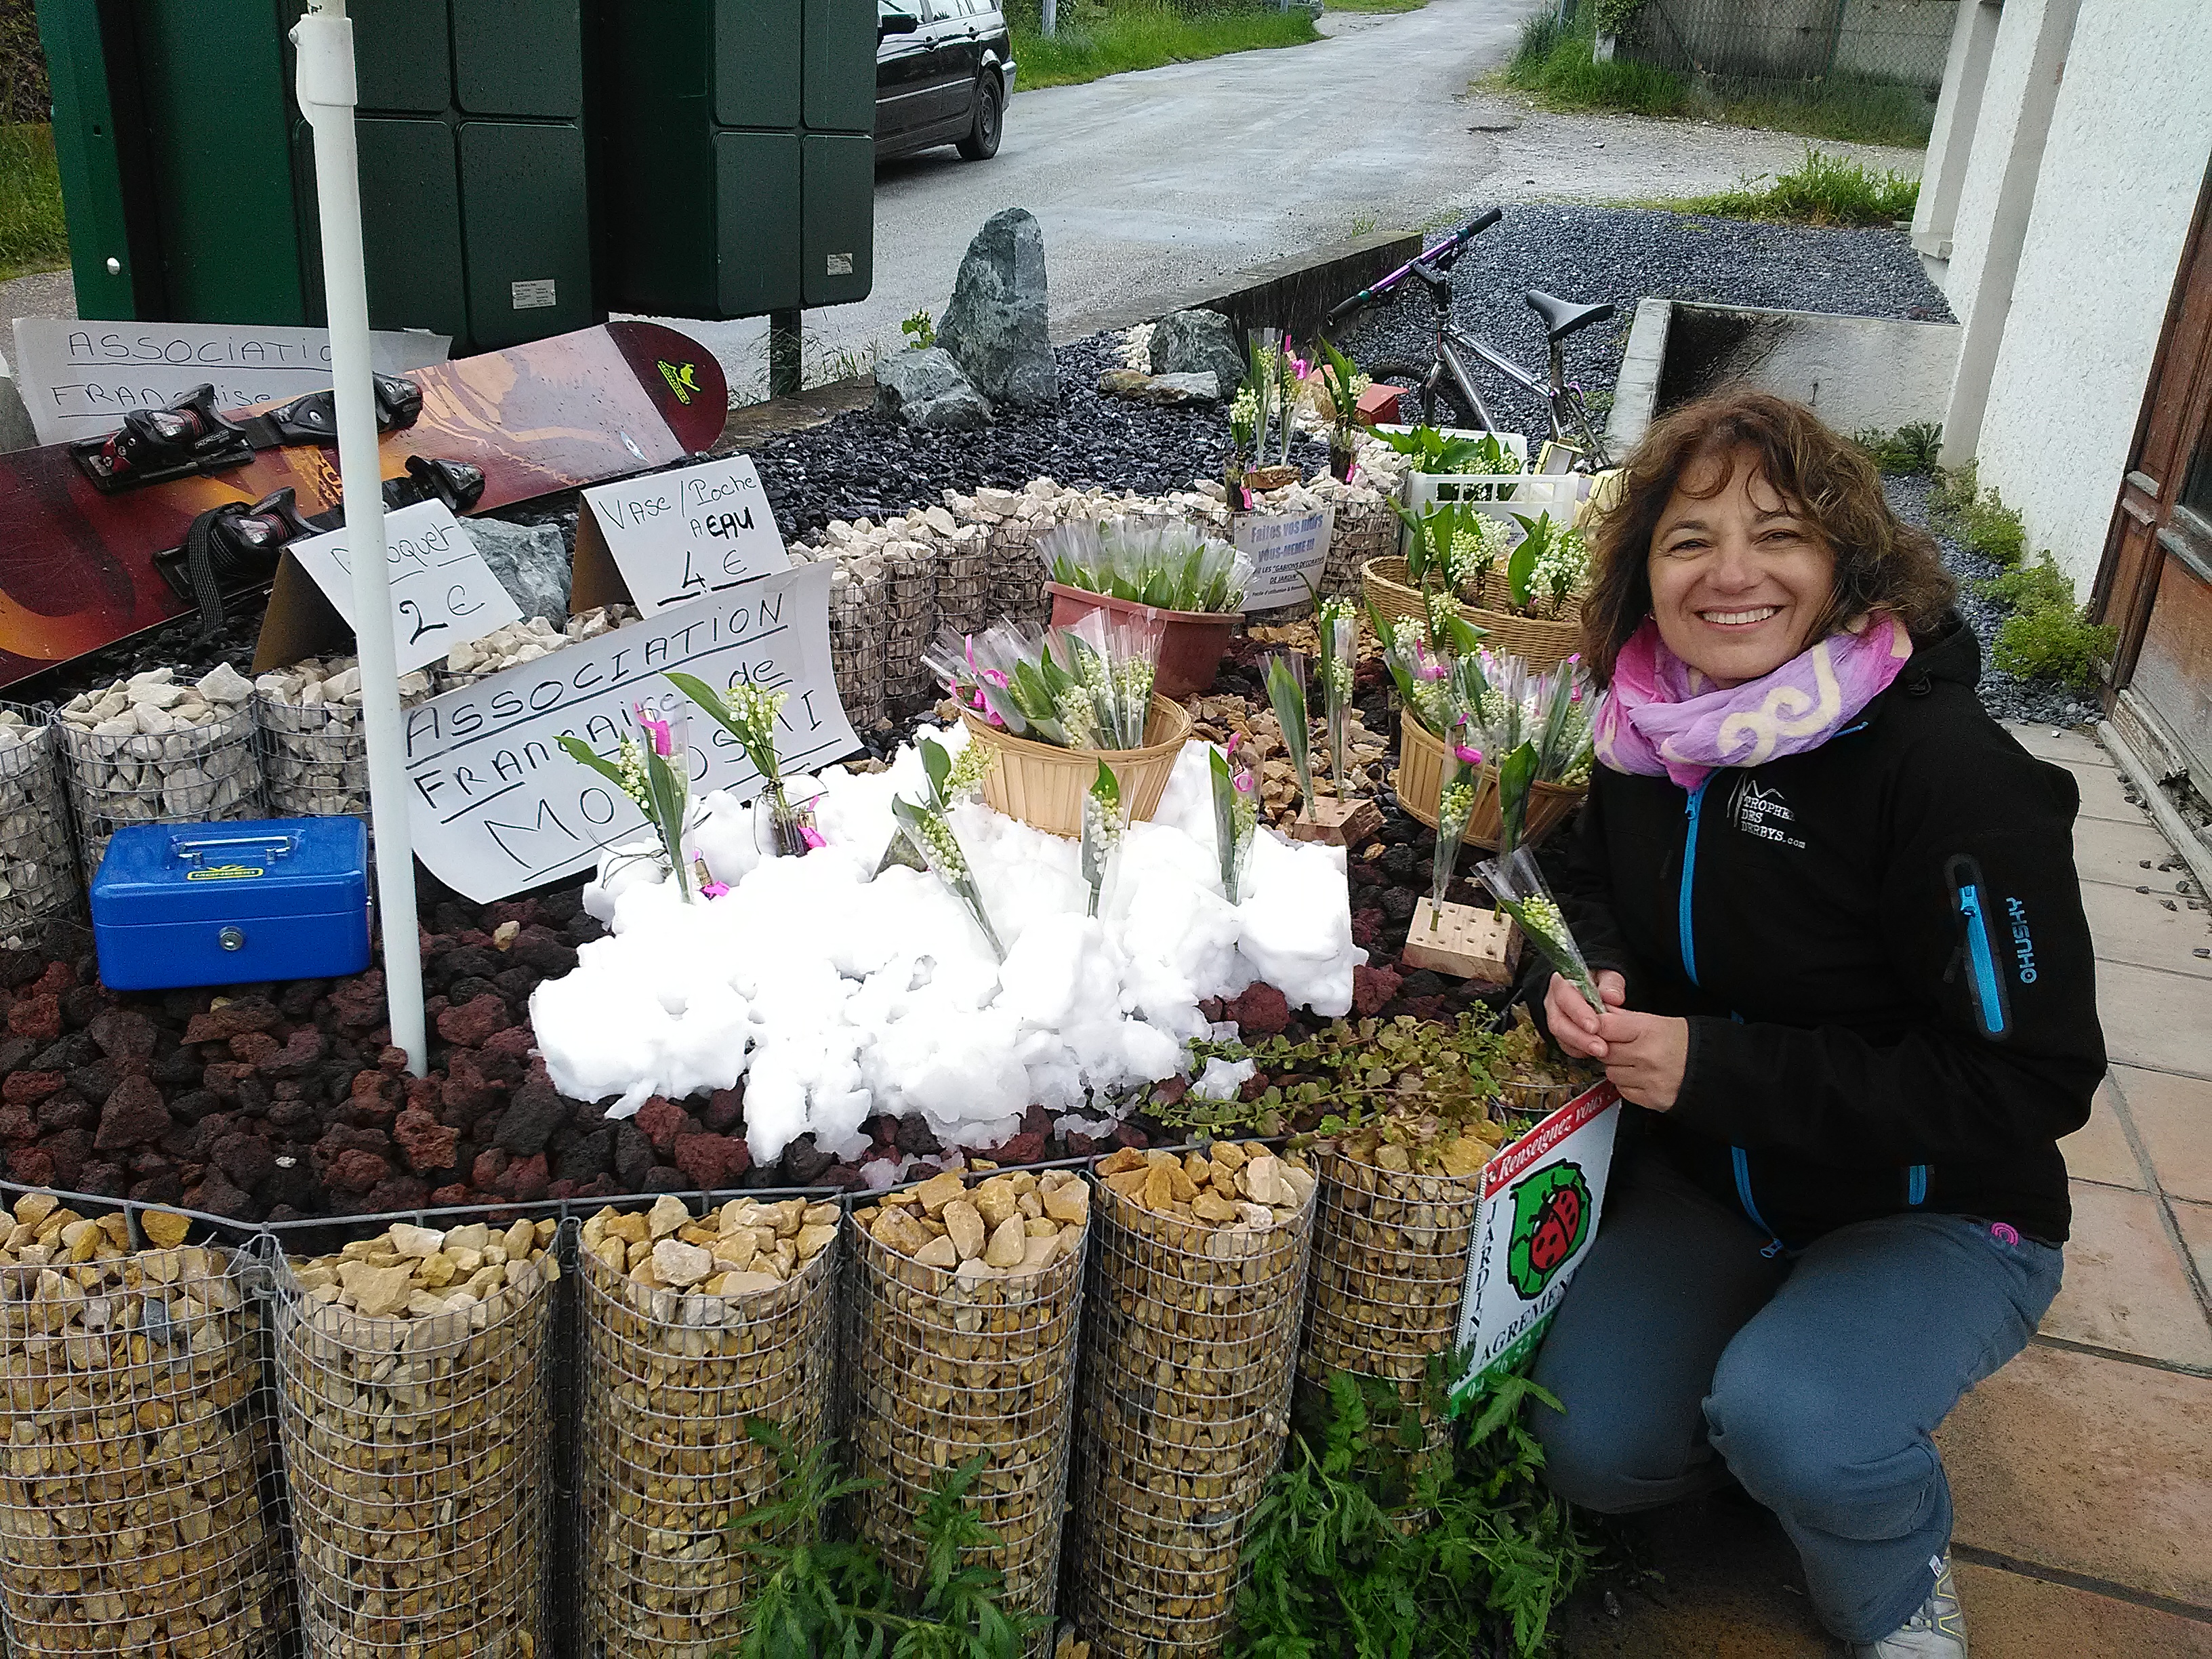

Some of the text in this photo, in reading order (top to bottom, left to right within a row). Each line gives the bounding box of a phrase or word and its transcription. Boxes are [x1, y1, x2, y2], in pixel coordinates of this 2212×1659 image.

[1251, 525, 1282, 544] Faites
[722, 549, 747, 575] €
[398, 585, 485, 645] 2 €
[1740, 808, 1764, 823] DES
[1740, 821, 1806, 849] DERBYS.com
[1498, 1092, 1602, 1183] Renseignez vous
